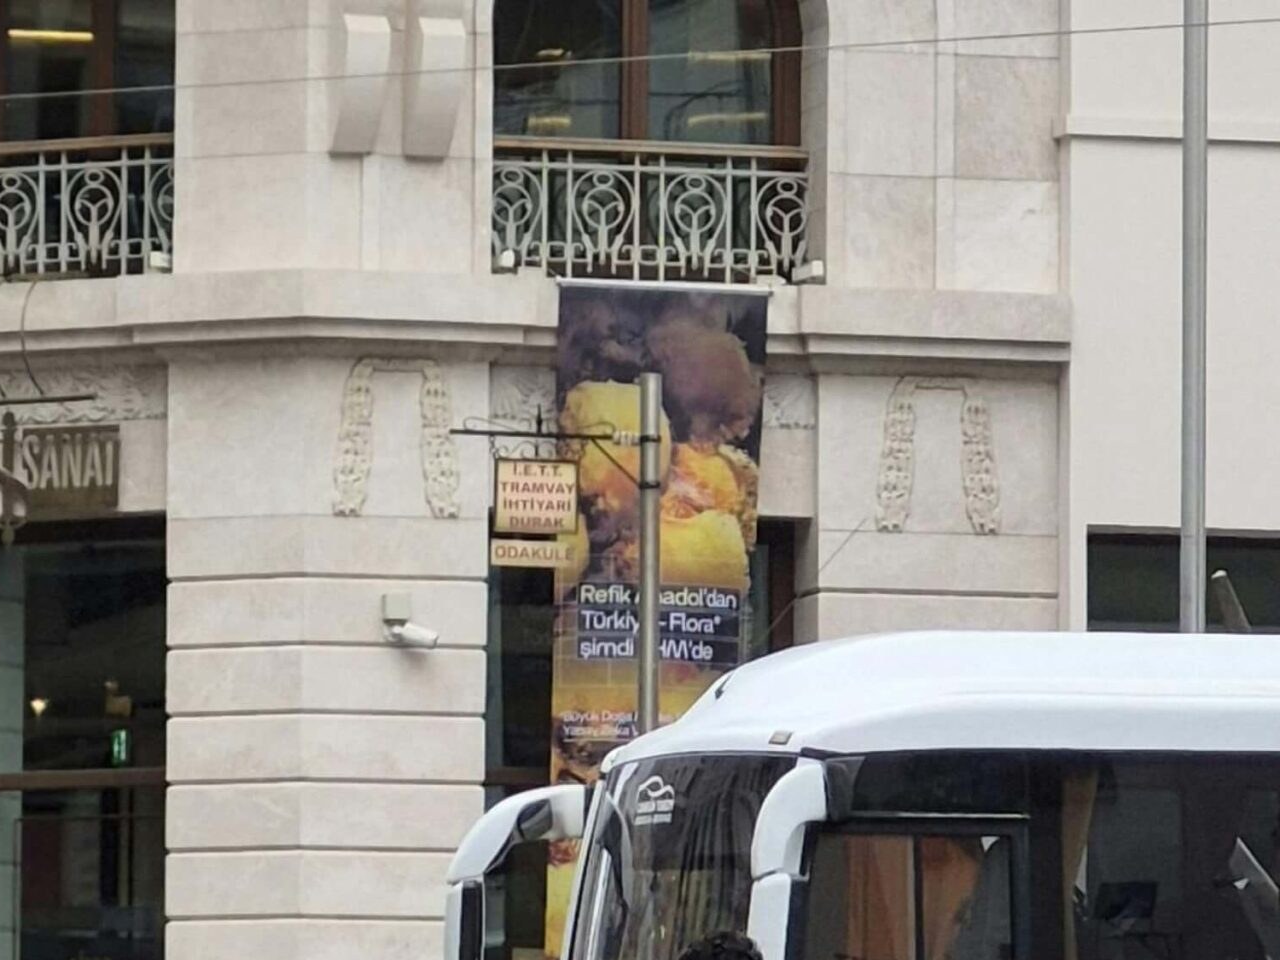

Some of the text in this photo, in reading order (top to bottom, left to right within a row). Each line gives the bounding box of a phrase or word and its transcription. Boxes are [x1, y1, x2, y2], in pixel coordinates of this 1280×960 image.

[22, 432, 118, 490] SANAT
[501, 481, 575, 495] TRAMVAY
[509, 516, 565, 529] DURAK
[495, 546, 575, 561] ODAKULE
[580, 584, 632, 604] Refik
[581, 609, 640, 634] Türkiy
[580, 637, 634, 659] şimdi
